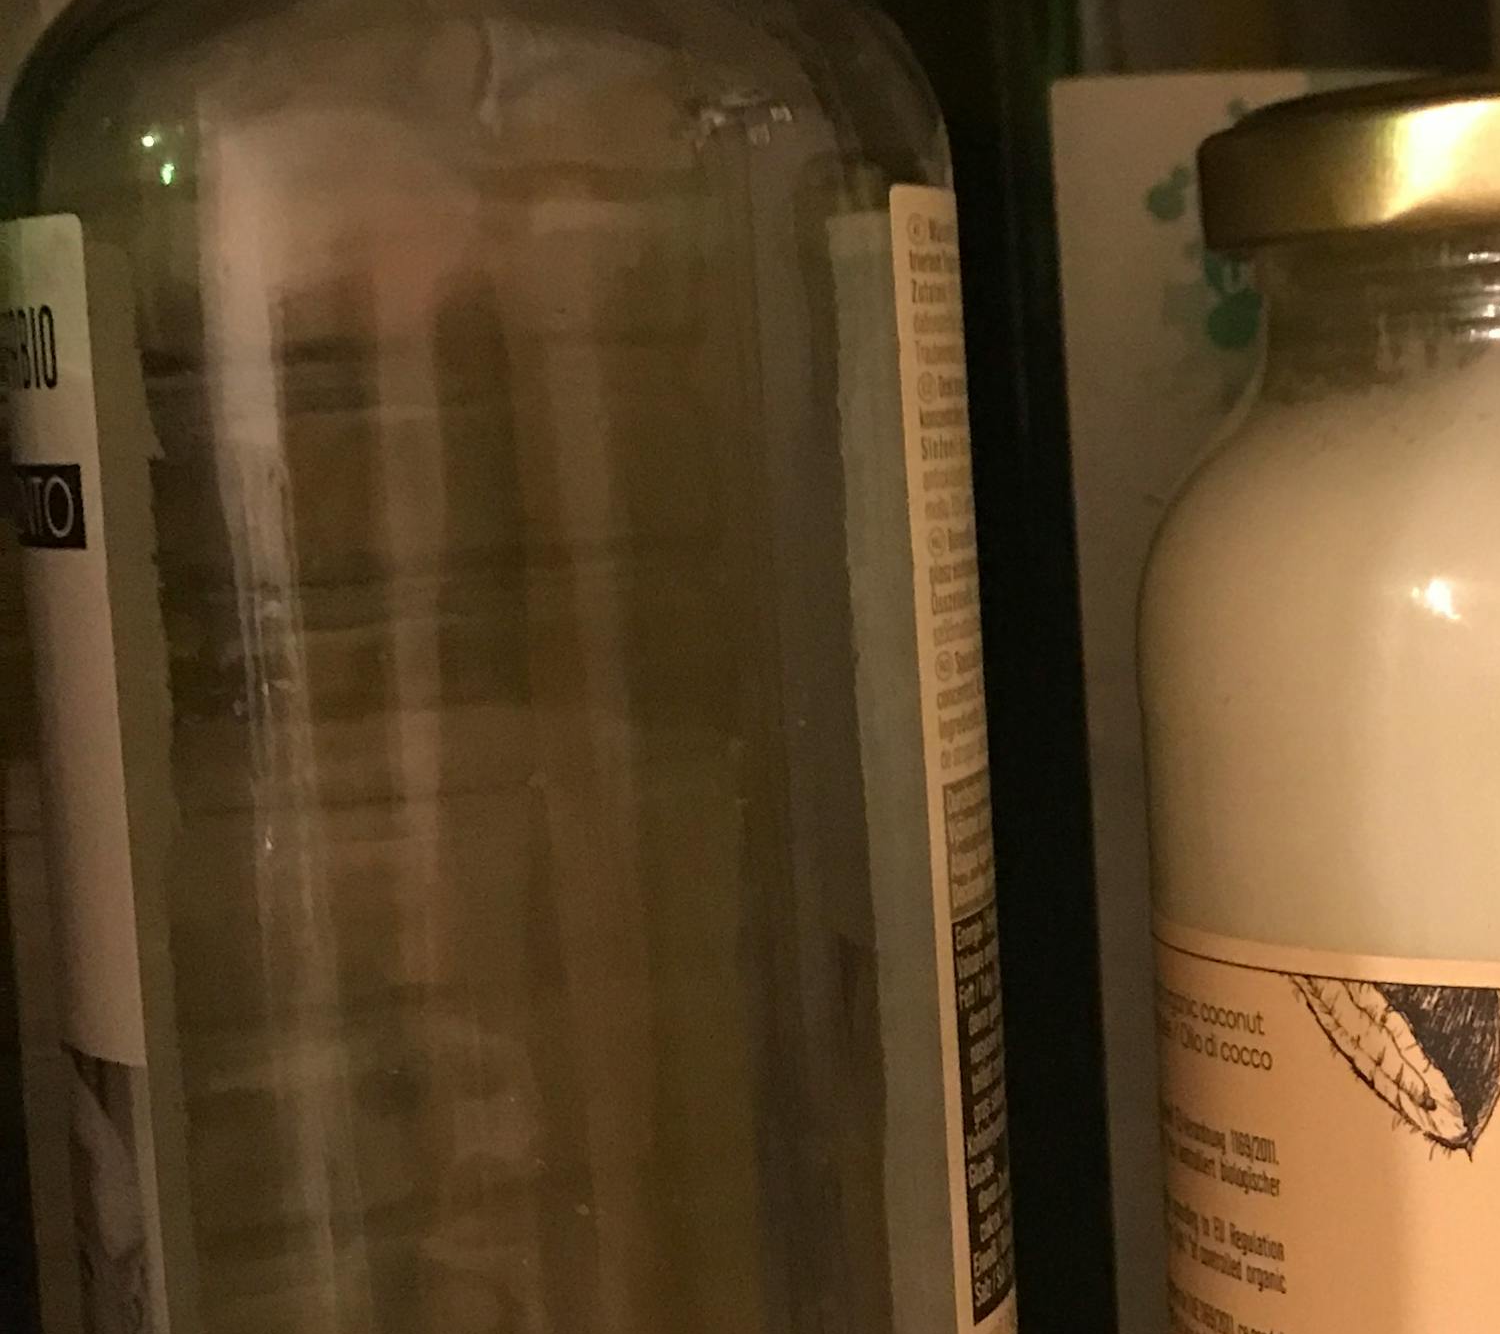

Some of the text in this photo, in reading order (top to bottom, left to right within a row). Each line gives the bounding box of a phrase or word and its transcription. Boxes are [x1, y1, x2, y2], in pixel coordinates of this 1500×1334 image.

[1201, 1002, 1265, 1035] coconut
[1205, 1032, 1217, 1058] di
[1220, 1041, 1273, 1071] cocco
[1230, 1222, 1286, 1262] Regulation
